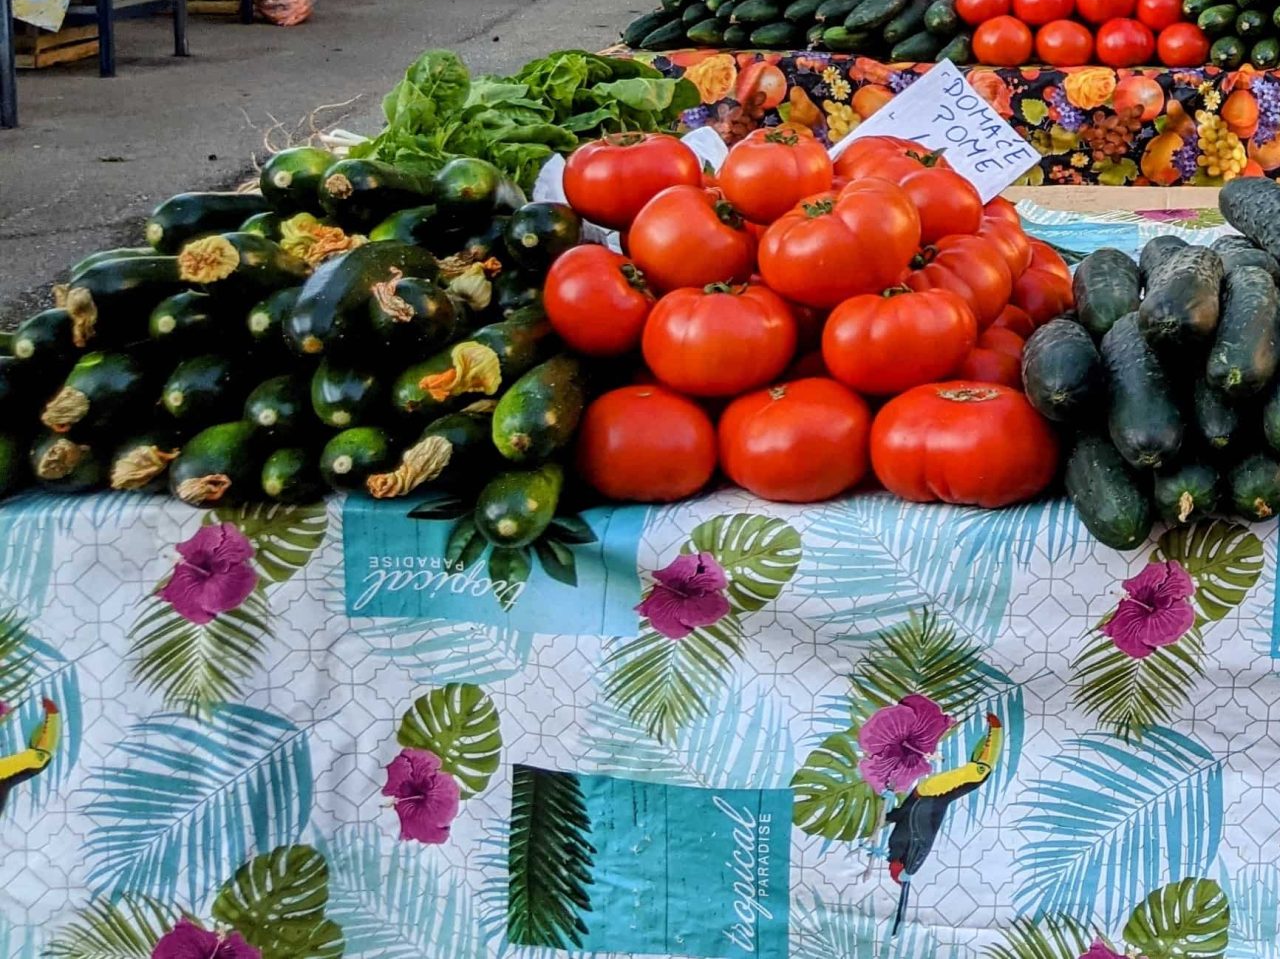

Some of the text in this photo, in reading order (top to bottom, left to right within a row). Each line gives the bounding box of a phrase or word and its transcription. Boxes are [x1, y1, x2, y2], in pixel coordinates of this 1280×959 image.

[353, 560, 526, 613] tropical
[369, 556, 465, 571] PARADISE
[712, 796, 773, 952] tropical
[757, 813, 772, 897] PARADISE
